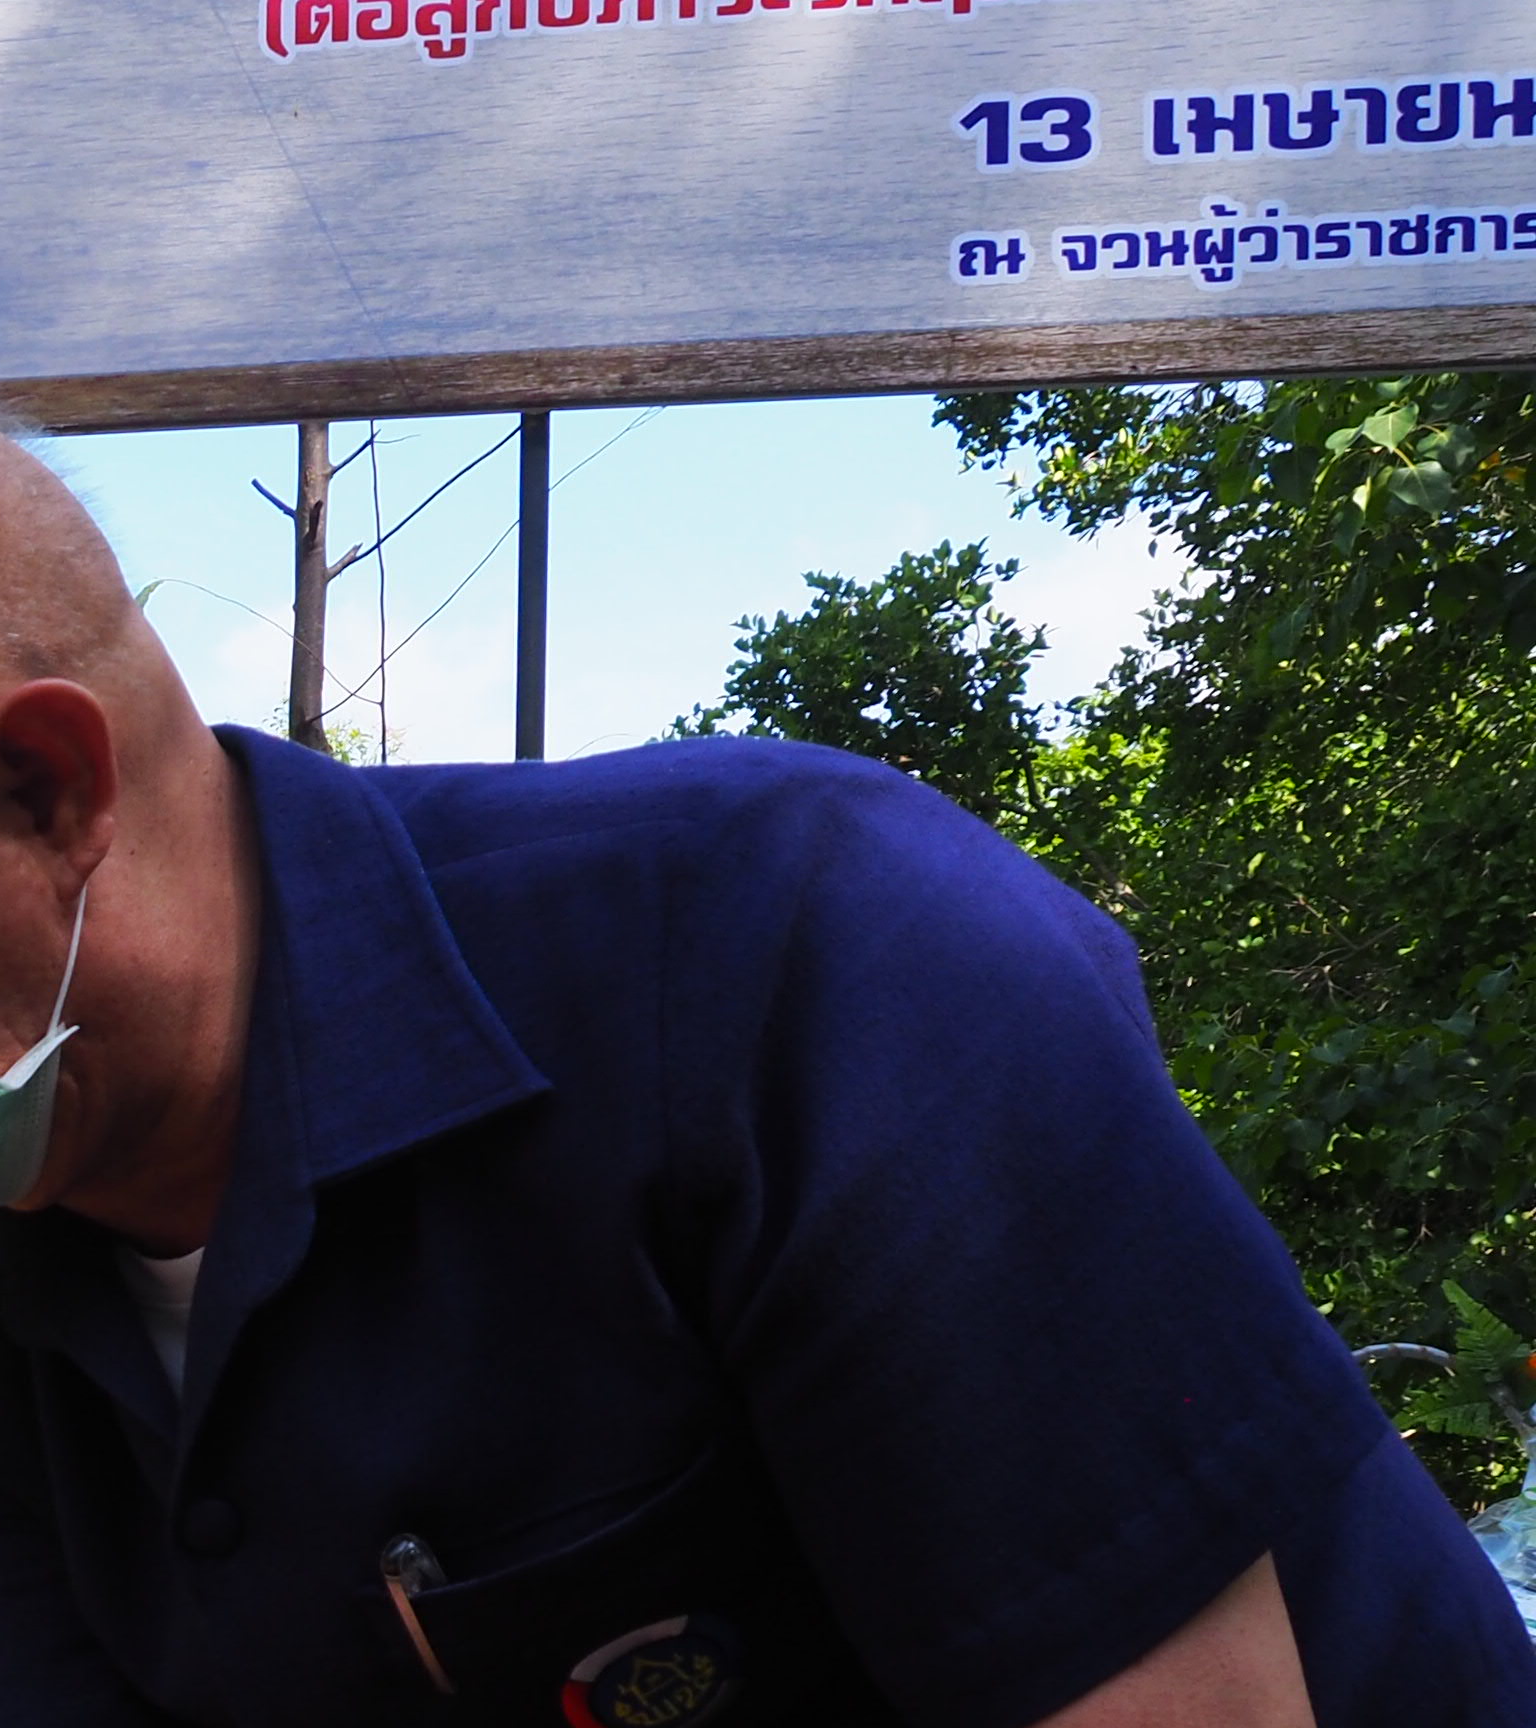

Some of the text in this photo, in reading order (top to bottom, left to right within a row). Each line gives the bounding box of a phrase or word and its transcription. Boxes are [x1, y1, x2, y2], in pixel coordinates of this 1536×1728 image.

[959, 78, 1536, 165] 13 เมษายน
[958, 237, 1026, 277] ณ
